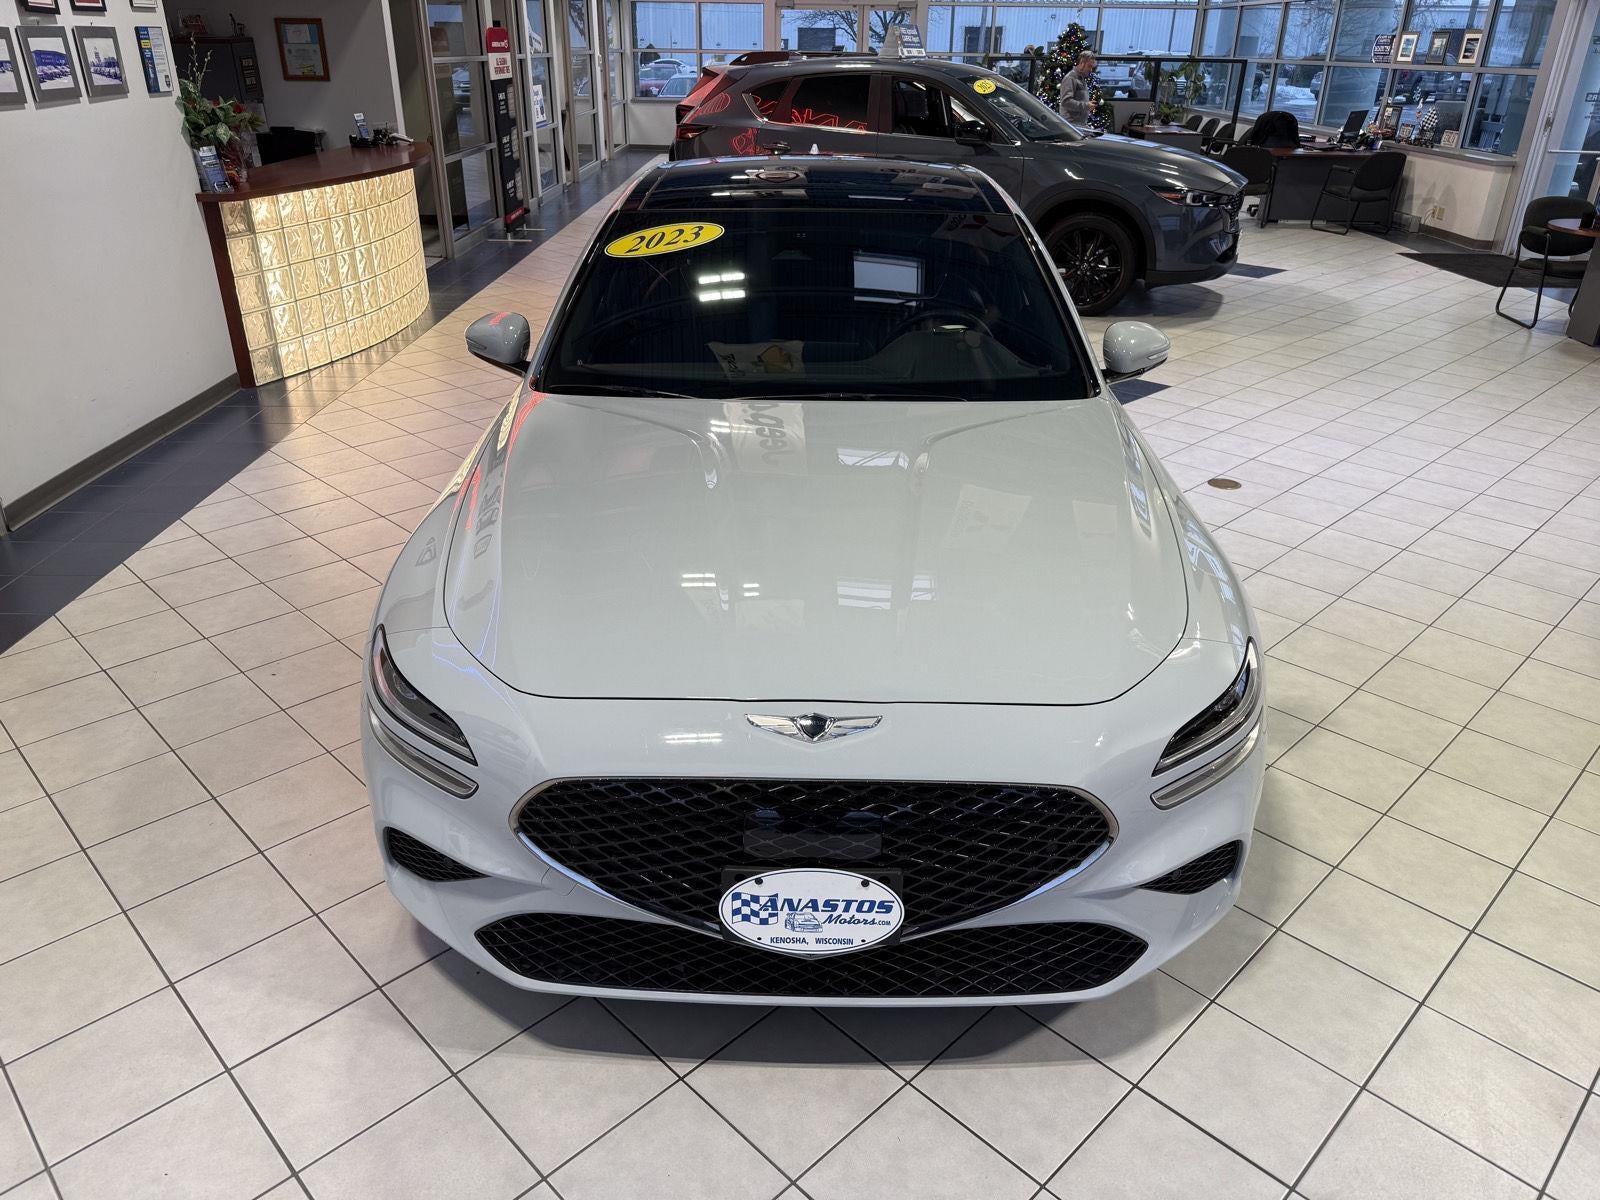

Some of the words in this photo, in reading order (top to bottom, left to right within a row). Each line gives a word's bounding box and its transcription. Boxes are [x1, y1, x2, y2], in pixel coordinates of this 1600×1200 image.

[625, 225, 705, 254] 2023
[759, 897, 894, 914] ANASTOS
[770, 936, 809, 946] KENOSHA,
[815, 937, 854, 946] WISCONSIN
